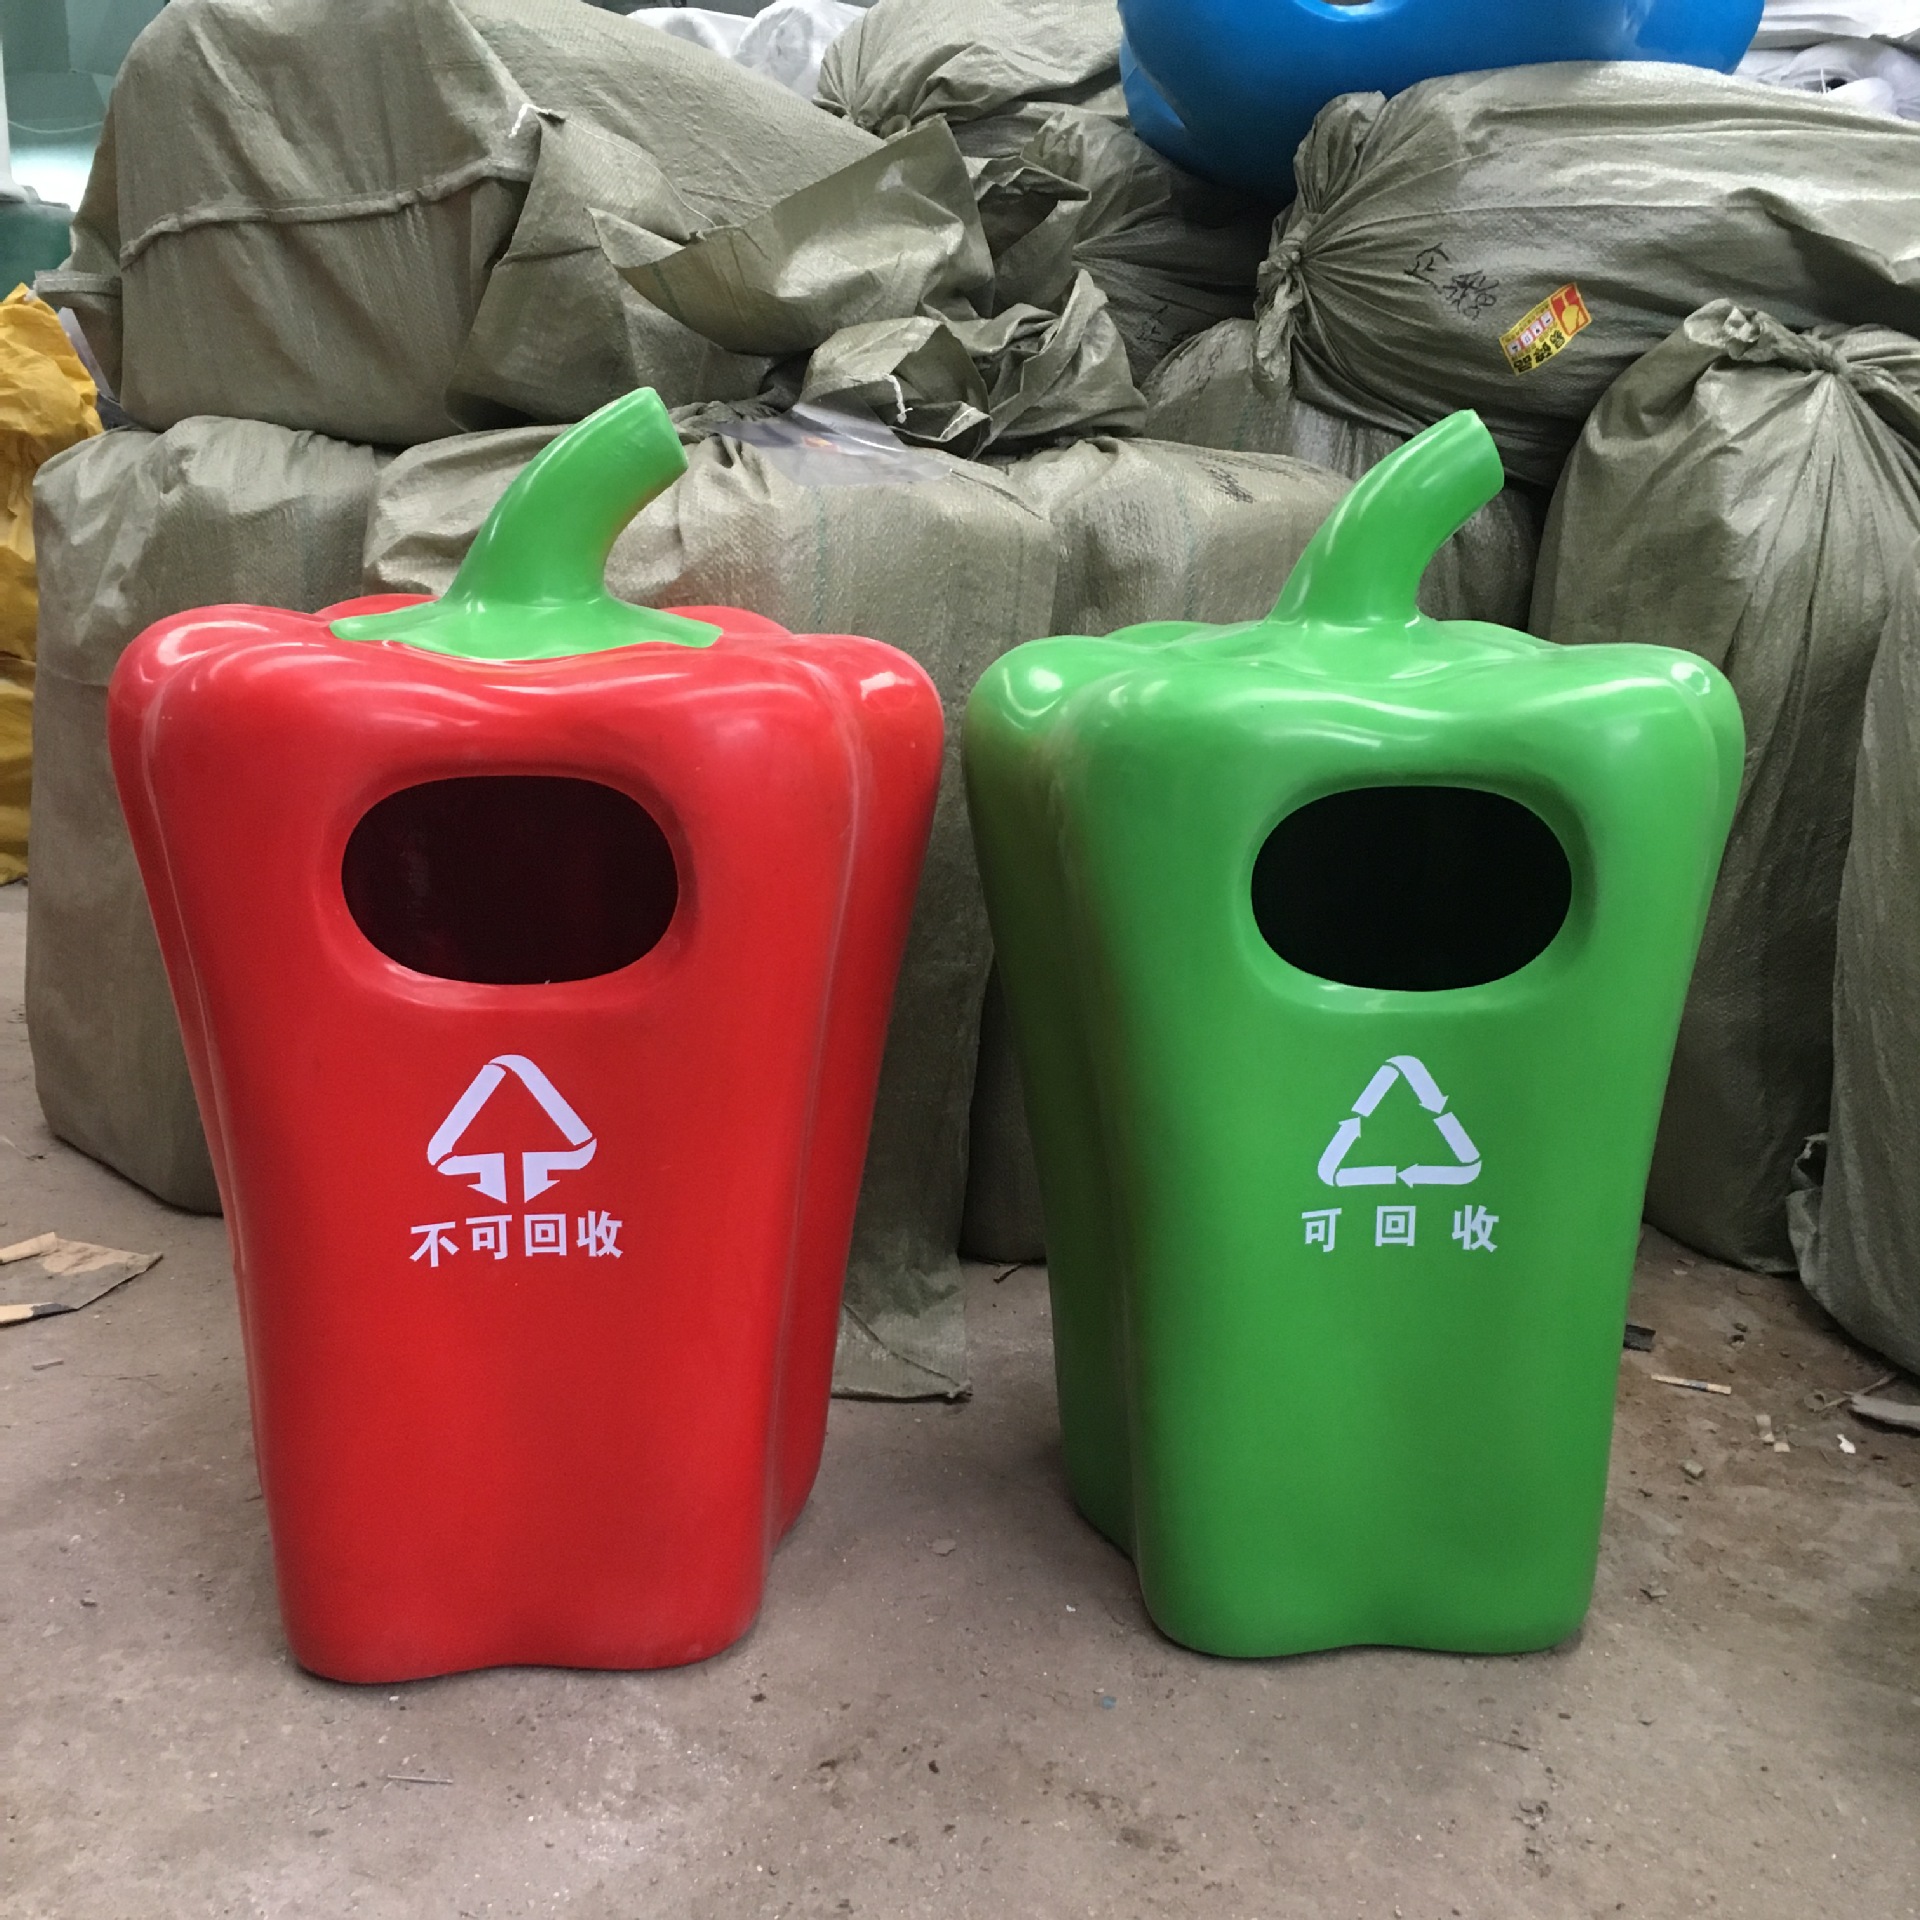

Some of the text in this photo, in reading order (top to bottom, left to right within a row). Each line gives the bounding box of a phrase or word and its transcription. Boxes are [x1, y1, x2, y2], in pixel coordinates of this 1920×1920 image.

[409, 1209, 624, 1268] 不可回收
[1301, 1204, 1500, 1253] 可回收
